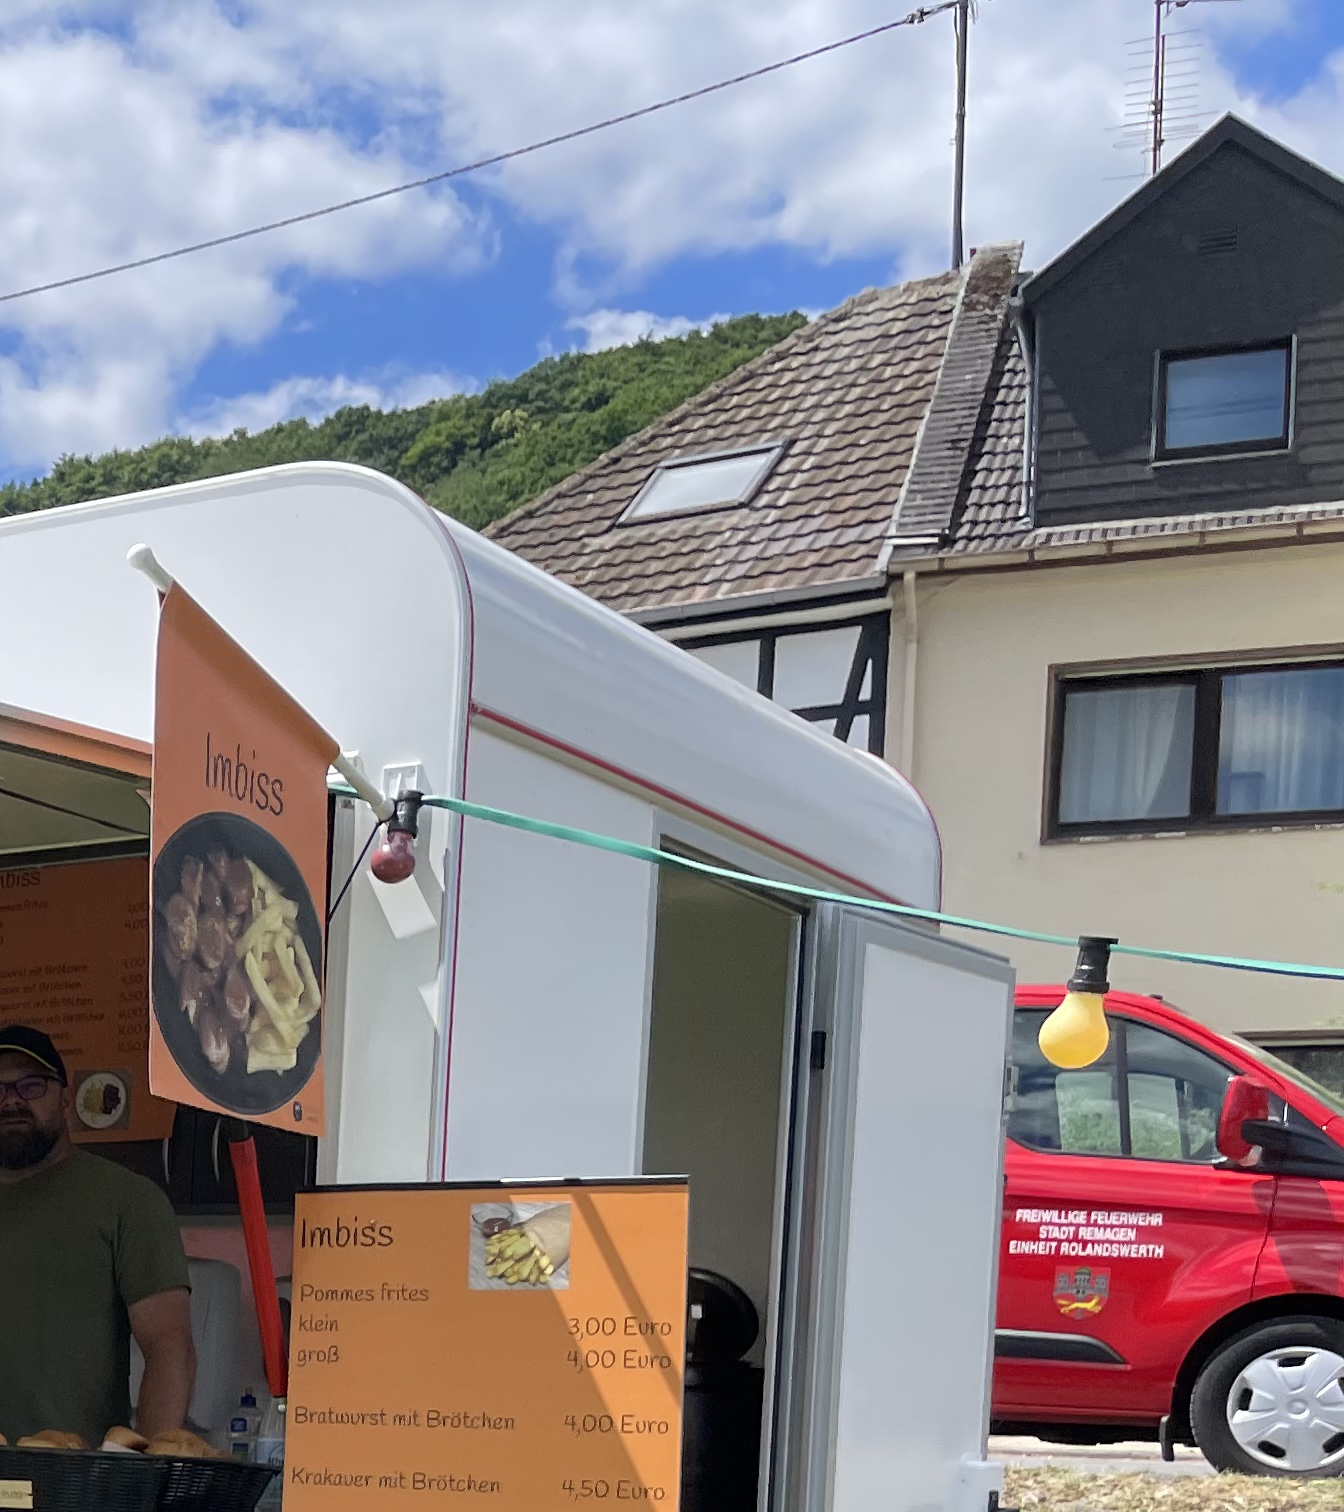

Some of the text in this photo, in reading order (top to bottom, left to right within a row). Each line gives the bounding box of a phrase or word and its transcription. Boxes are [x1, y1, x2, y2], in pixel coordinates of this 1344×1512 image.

[204, 730, 284, 816] Imbiss
[1015, 1208, 1164, 1226] FREIWILLIGE FEUERWEHR
[300, 1216, 394, 1250] Imbiss
[1039, 1226, 1136, 1242] STADT REMAGEN
[1008, 1240, 1164, 1258] EINHEIT ROLANDSWERTH
[300, 1281, 430, 1302] Pommes frites
[298, 1314, 672, 1342] klein 3,00 Euro
[296, 1346, 672, 1373] groß 4,00 Euro
[294, 1406, 670, 1440] Bratwurst mit Brötchen 4,00 Euro
[291, 1467, 666, 1502] Krakauer mit Brötchen 4,50 Euro
